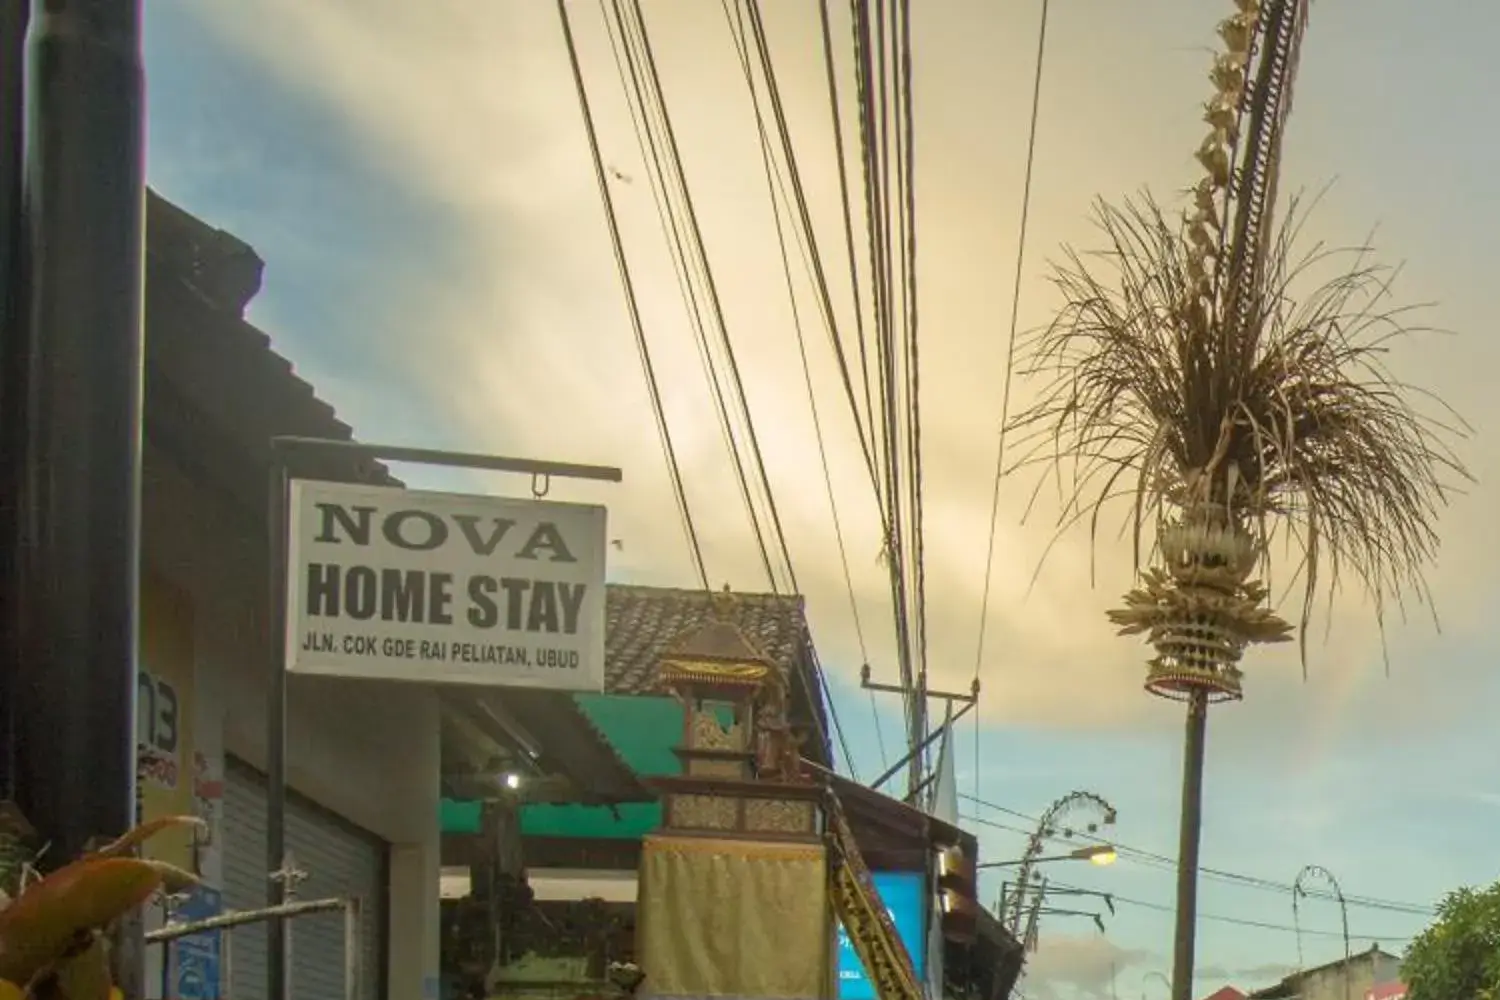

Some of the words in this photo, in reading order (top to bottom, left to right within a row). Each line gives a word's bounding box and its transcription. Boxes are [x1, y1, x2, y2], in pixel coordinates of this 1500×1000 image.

[313, 503, 578, 563] NOVA
[306, 563, 454, 625] HOME
[466, 575, 587, 635] STAY
[302, 631, 338, 653] JLN.
[343, 635, 377, 656] COK
[382, 637, 416, 659] GDE
[419, 639, 447, 662] RAI
[451, 641, 531, 668] PELIATAN,
[535, 646, 579, 669] UBUD
